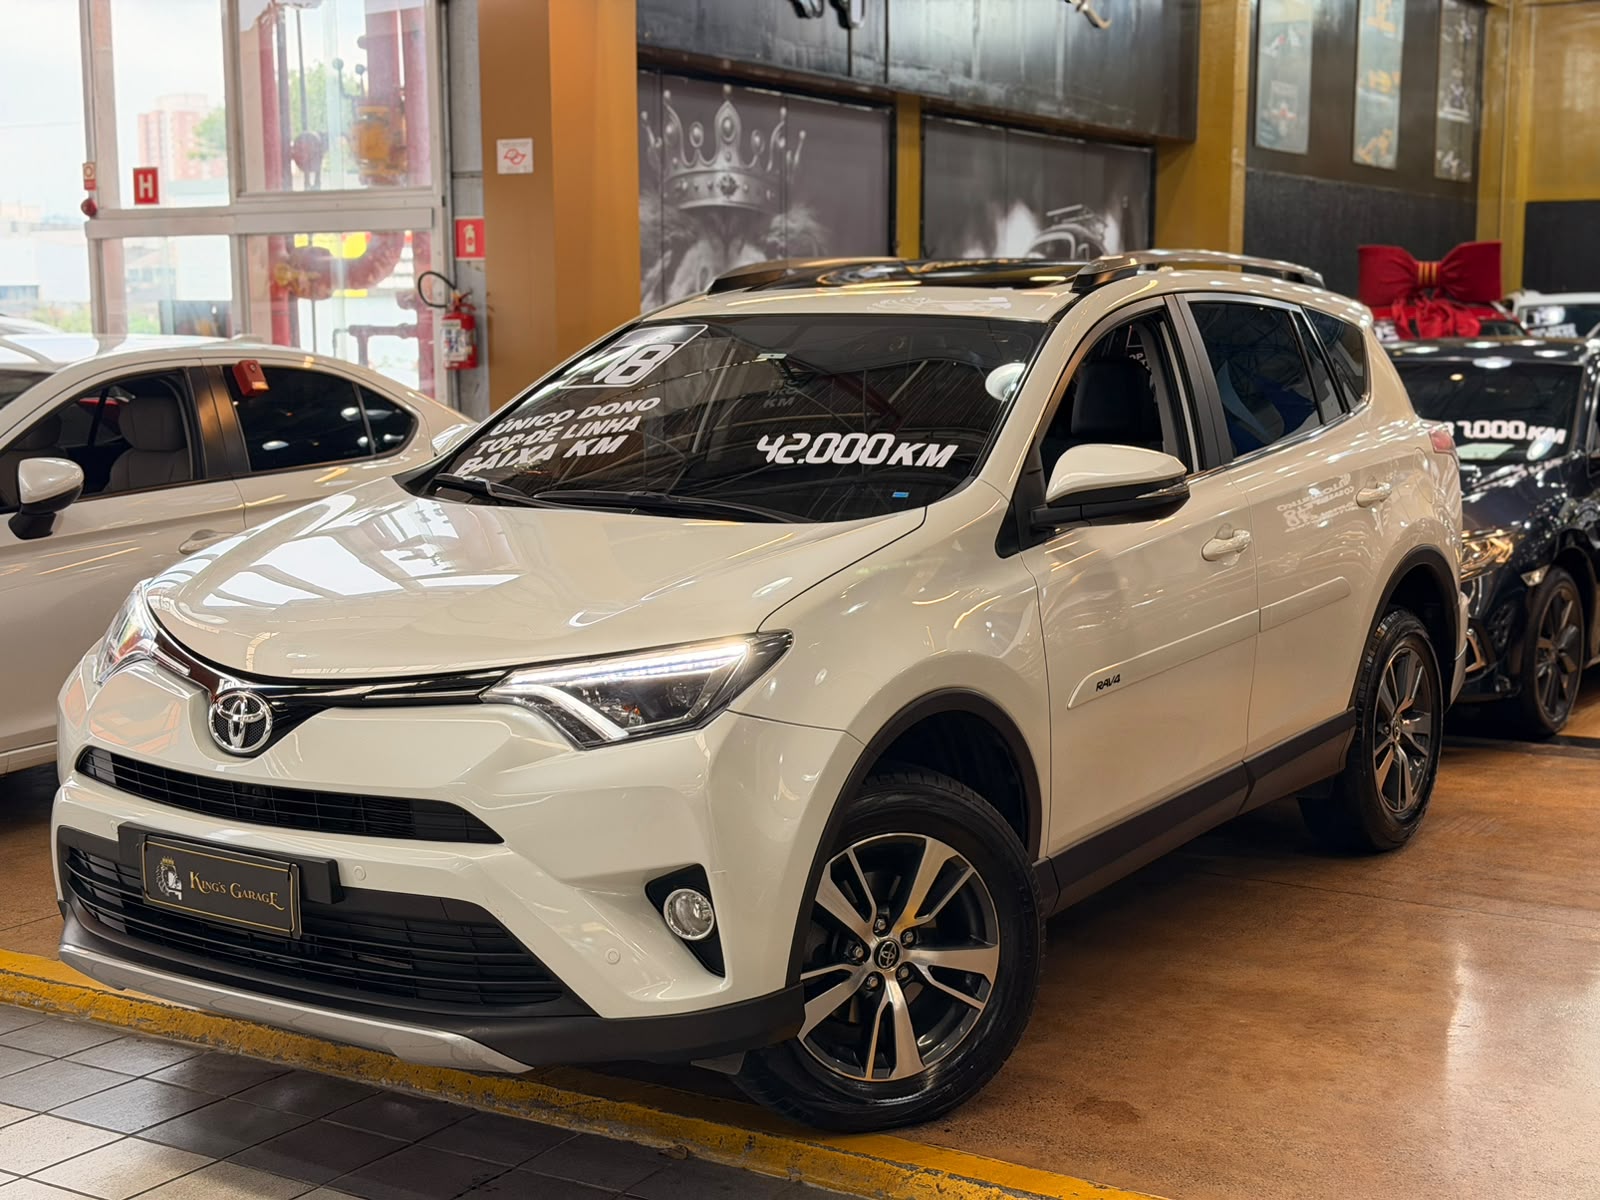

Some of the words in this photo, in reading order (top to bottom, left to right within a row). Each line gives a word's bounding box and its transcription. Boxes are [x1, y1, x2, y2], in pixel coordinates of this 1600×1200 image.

[138, 173, 155, 200] H
[593, 344, 665, 384] 18
[474, 433, 526, 456] TOP
[521, 426, 564, 446] DE
[560, 416, 642, 440] LINHA
[490, 408, 576, 437] ÚNICO
[576, 397, 661, 420] DONO
[453, 443, 559, 477] BAIXA
[562, 434, 629, 459] KM
[1095, 673, 1121, 692] RAV4
